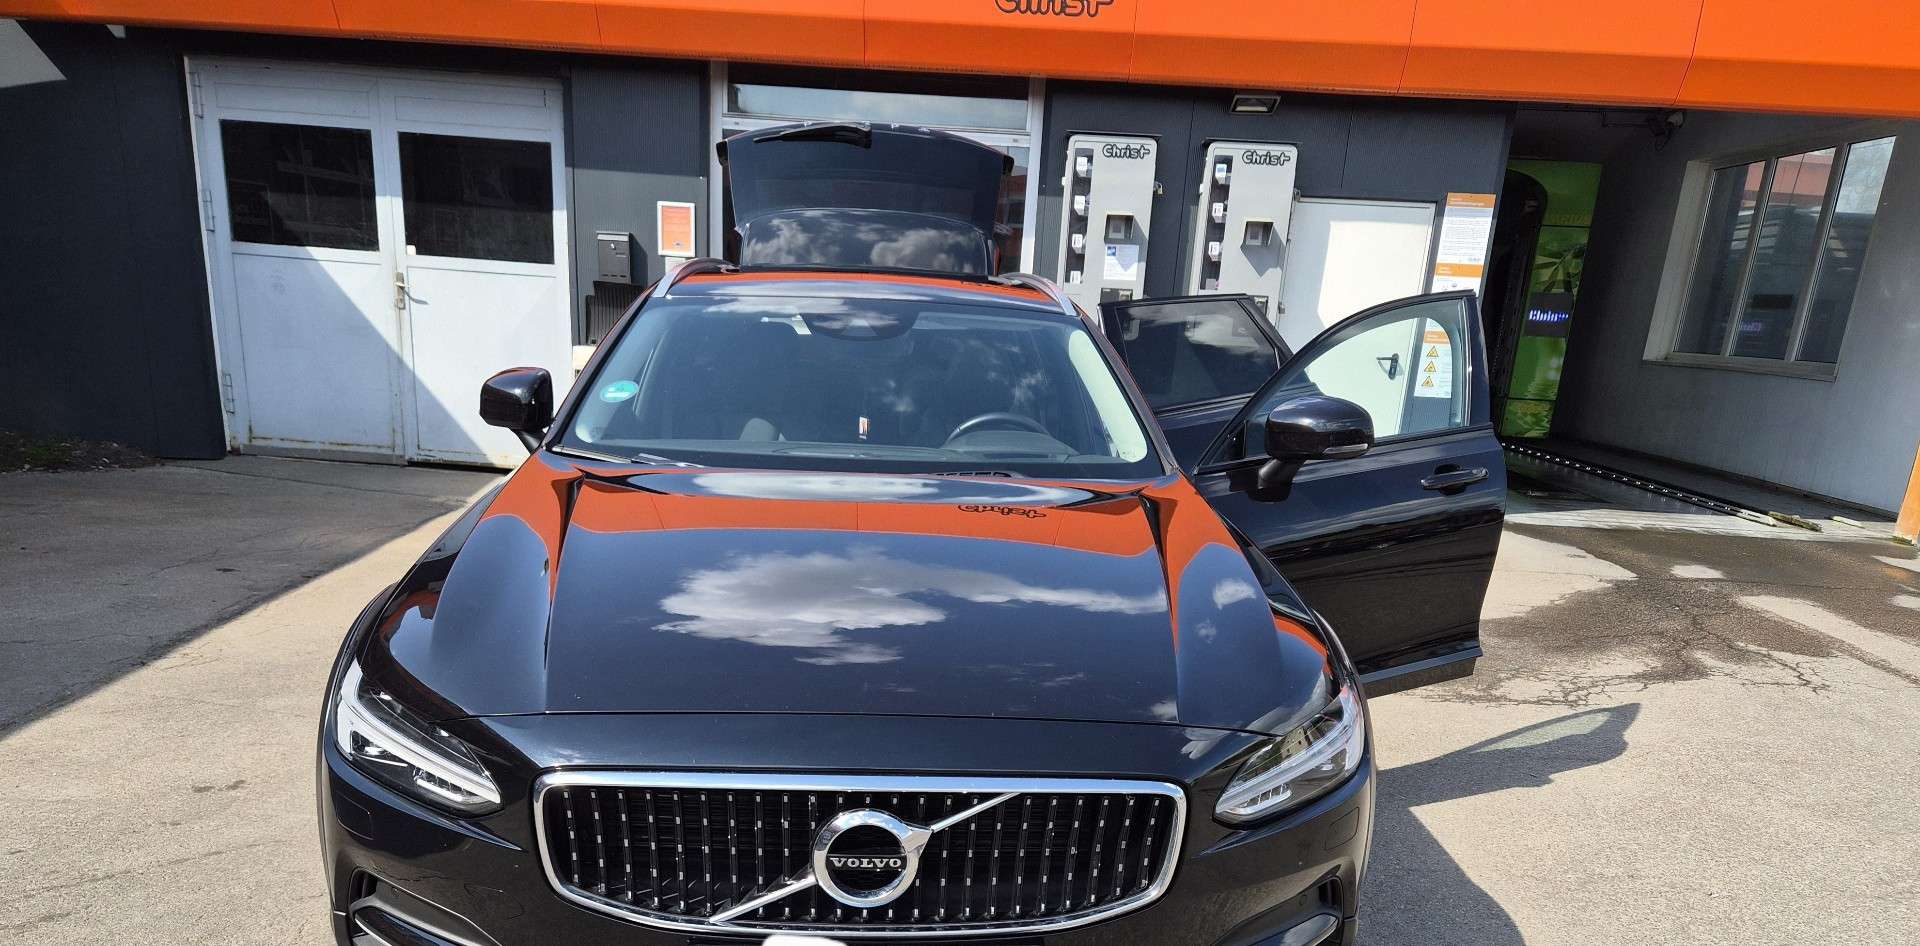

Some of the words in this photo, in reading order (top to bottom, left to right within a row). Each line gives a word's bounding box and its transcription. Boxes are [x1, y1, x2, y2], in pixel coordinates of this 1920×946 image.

[1102, 143, 1151, 160] Christ
[1241, 150, 1290, 166] Christ
[829, 857, 902, 868] VOLVO
